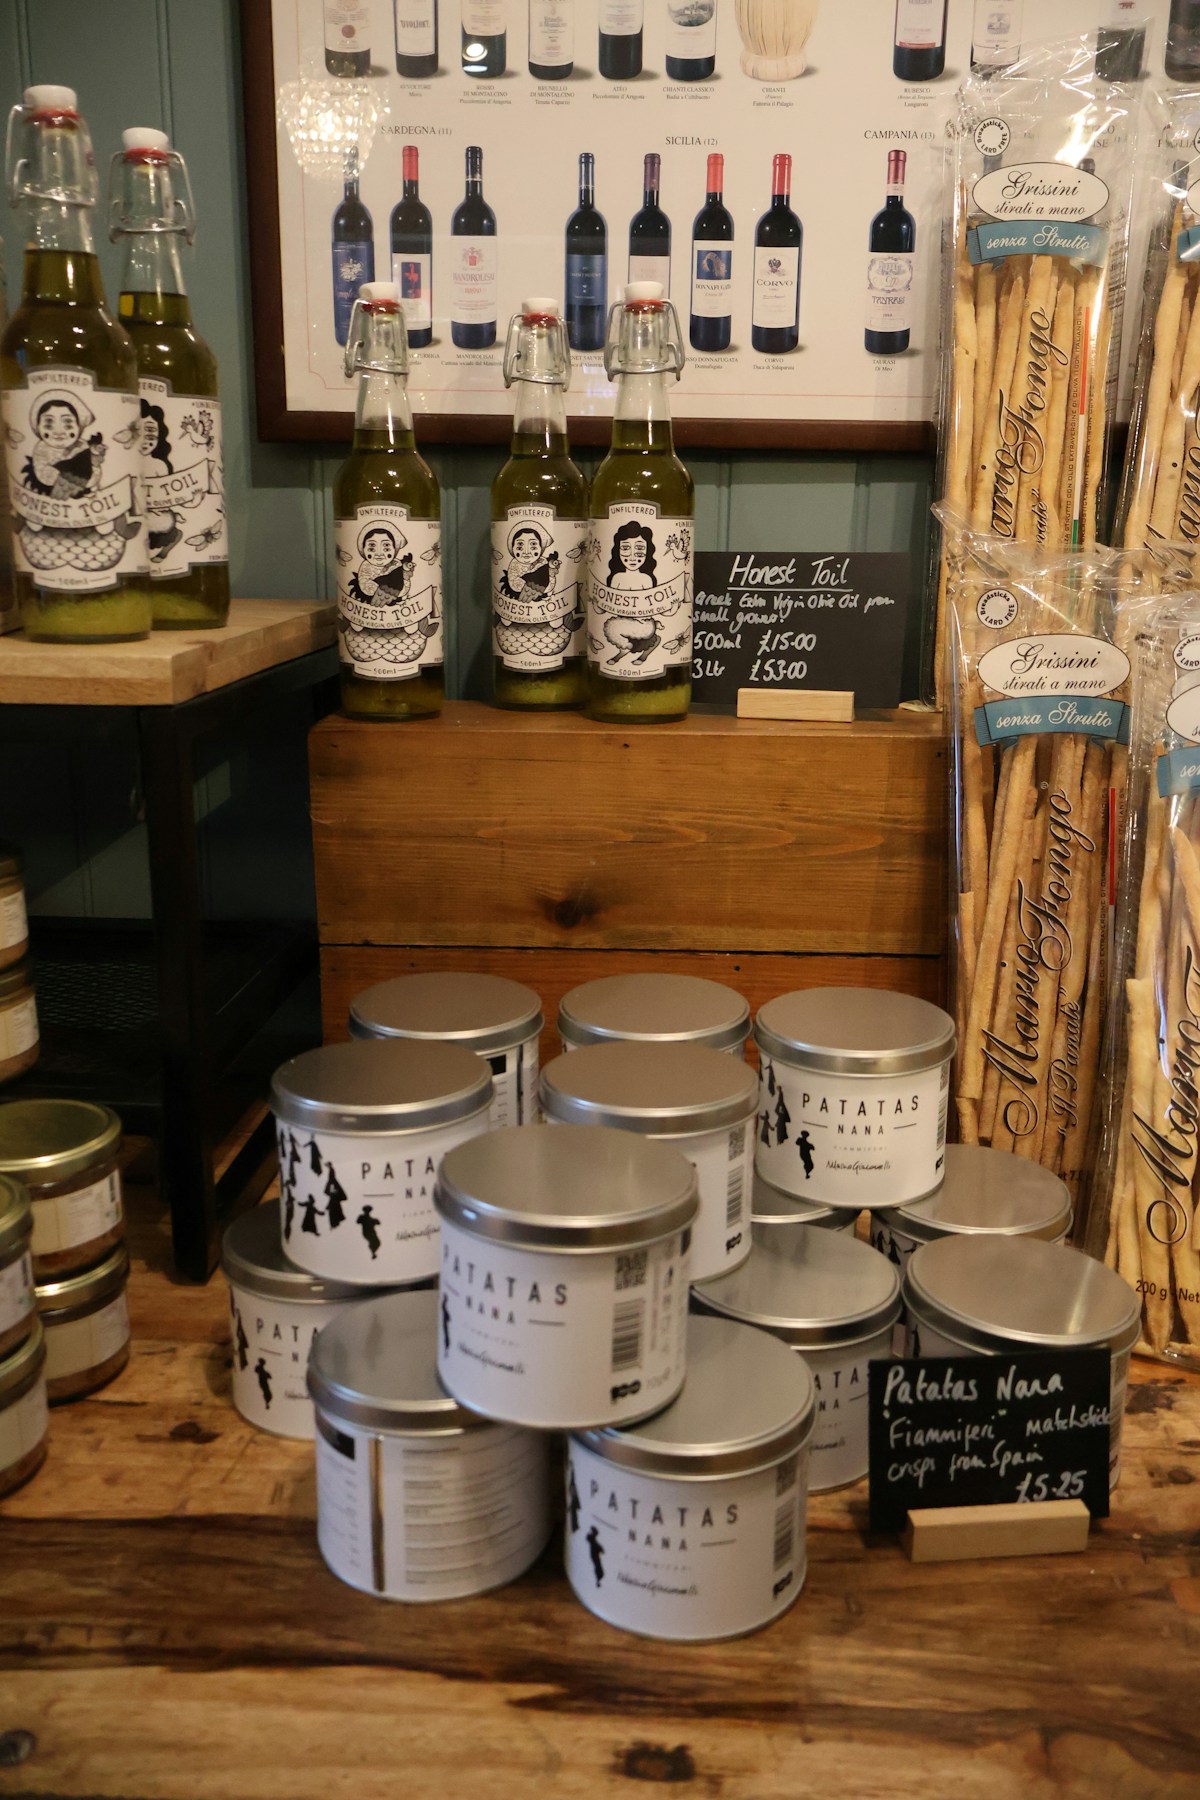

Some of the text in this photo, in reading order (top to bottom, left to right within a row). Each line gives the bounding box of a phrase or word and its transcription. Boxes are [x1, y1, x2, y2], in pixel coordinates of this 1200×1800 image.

[381, 126, 436, 135] SARDEGNA
[665, 136, 718, 146] SICILIA (12)
[864, 130, 935, 140] CAMPANIA (13)
[981, 132, 1008, 153] LARD FREE
[1001, 170, 1081, 200] Grissini
[1036, 206, 1045, 215] a
[1048, 206, 1086, 216] mano
[986, 225, 1090, 250] senza Strutto
[756, 278, 793, 287] CORVO
[30, 374, 90, 386] UNFILTERED
[160, 473, 198, 496] TOIL
[79, 493, 120, 518] TOIL
[359, 508, 404, 518] UNFILTERED
[509, 509, 550, 518] UNFILTERED
[610, 505, 655, 516] UNFILTERED
[729, 554, 850, 586] Honest Toil
[494, 594, 569, 616] HONEST TOIL
[592, 582, 677, 607] HONEST TOIL
[980, 591, 1010, 615] Breadsticks
[341, 596, 424, 621] HONEST TOIL
[602, 602, 666, 616] EXTRA VIRGIN OLIVE OIL
[692, 608, 729, 623] small
[774, 593, 804, 619] Virgin
[807, 593, 836, 609] Olive
[839, 593, 859, 608] Oil
[985, 604, 1015, 625] LARD FREE
[351, 616, 365, 626] EXTRA
[694, 629, 817, 656] 500ml £15.00
[1010, 643, 1101, 674] Grissini
[1180, 657, 1200, 668] LARD
[749, 659, 808, 681] £53.00
[1002, 676, 1106, 690] stirati a mano
[996, 700, 1113, 729] senza Strutto
[1018, 788, 1096, 972] Fongo
[981, 942, 1040, 1137] Mario
[802, 1092, 919, 1116] PATATAS
[837, 1125, 884, 1135] NANA
[362, 1156, 435, 1180] PATA
[406, 1186, 427, 1199] NA
[1135, 1280, 1200, 1303] 200 g Net
[465, 1296, 515, 1324] NANA
[883, 1365, 978, 1406] Patatas
[996, 1365, 1064, 1401] Nana
[819, 1398, 839, 1412] NA
[950, 1454, 986, 1481] from
[990, 1440, 1044, 1477] Spain
[590, 1479, 739, 1527] PATATAS
[628, 1529, 688, 1551] NANA
